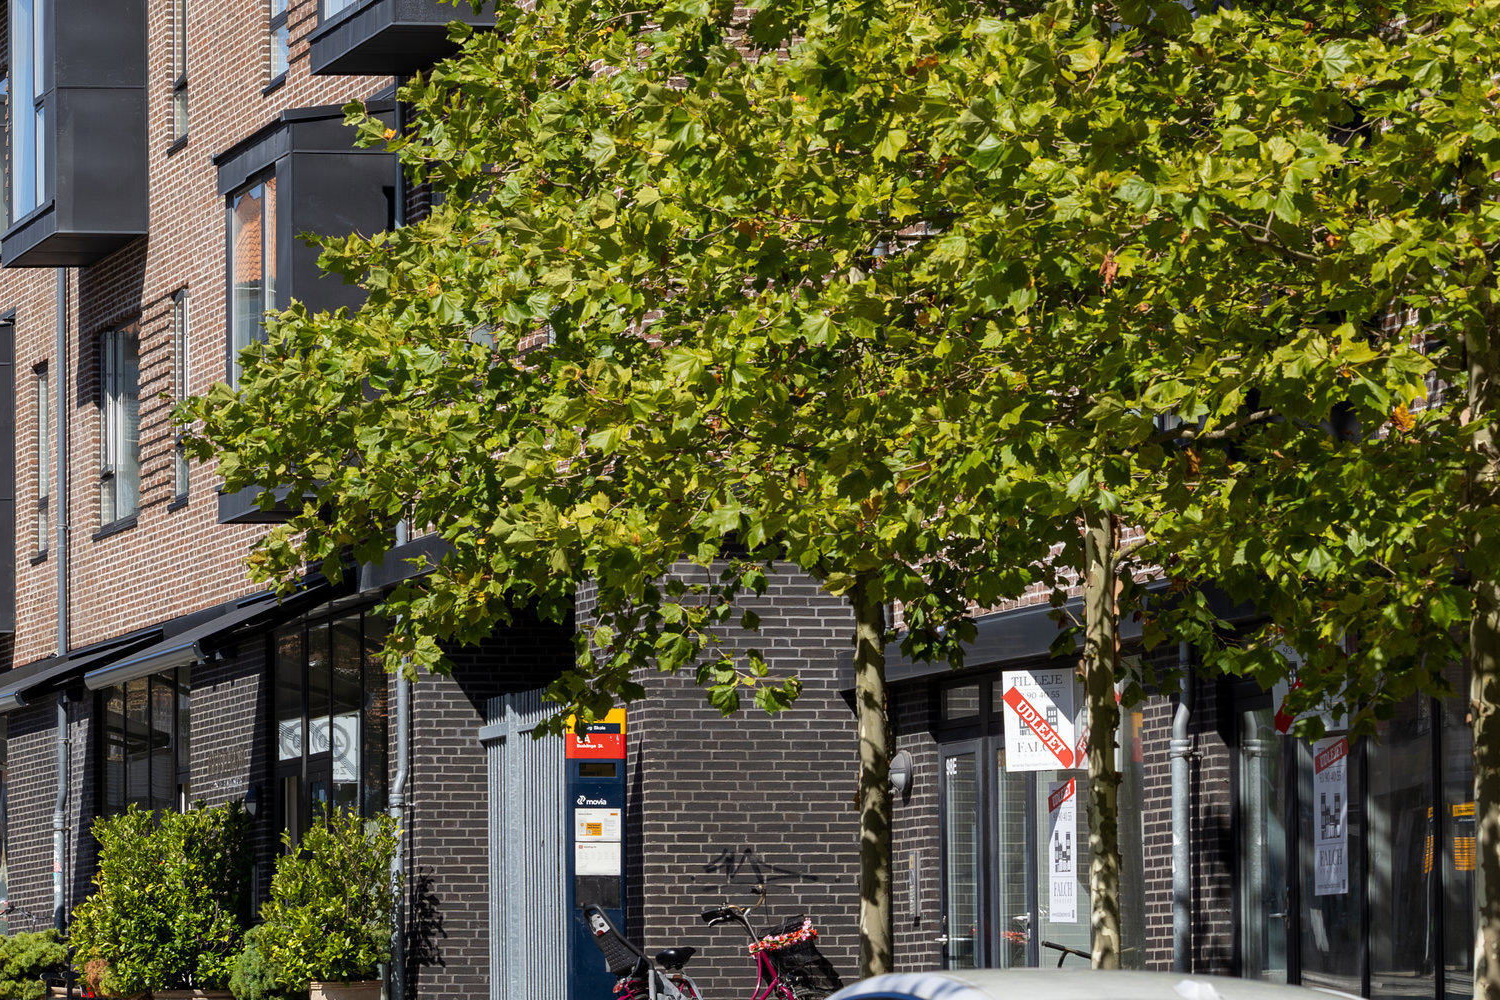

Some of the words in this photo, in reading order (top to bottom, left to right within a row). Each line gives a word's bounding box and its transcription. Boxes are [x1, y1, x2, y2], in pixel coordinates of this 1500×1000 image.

[1011, 676, 1031, 686] TIL
[1034, 674, 1063, 686] LEJE
[1027, 691, 1037, 699] 90
[1039, 691, 1049, 699] 40
[1051, 690, 1060, 698] 55
[1016, 699, 1067, 755] UDLEJET
